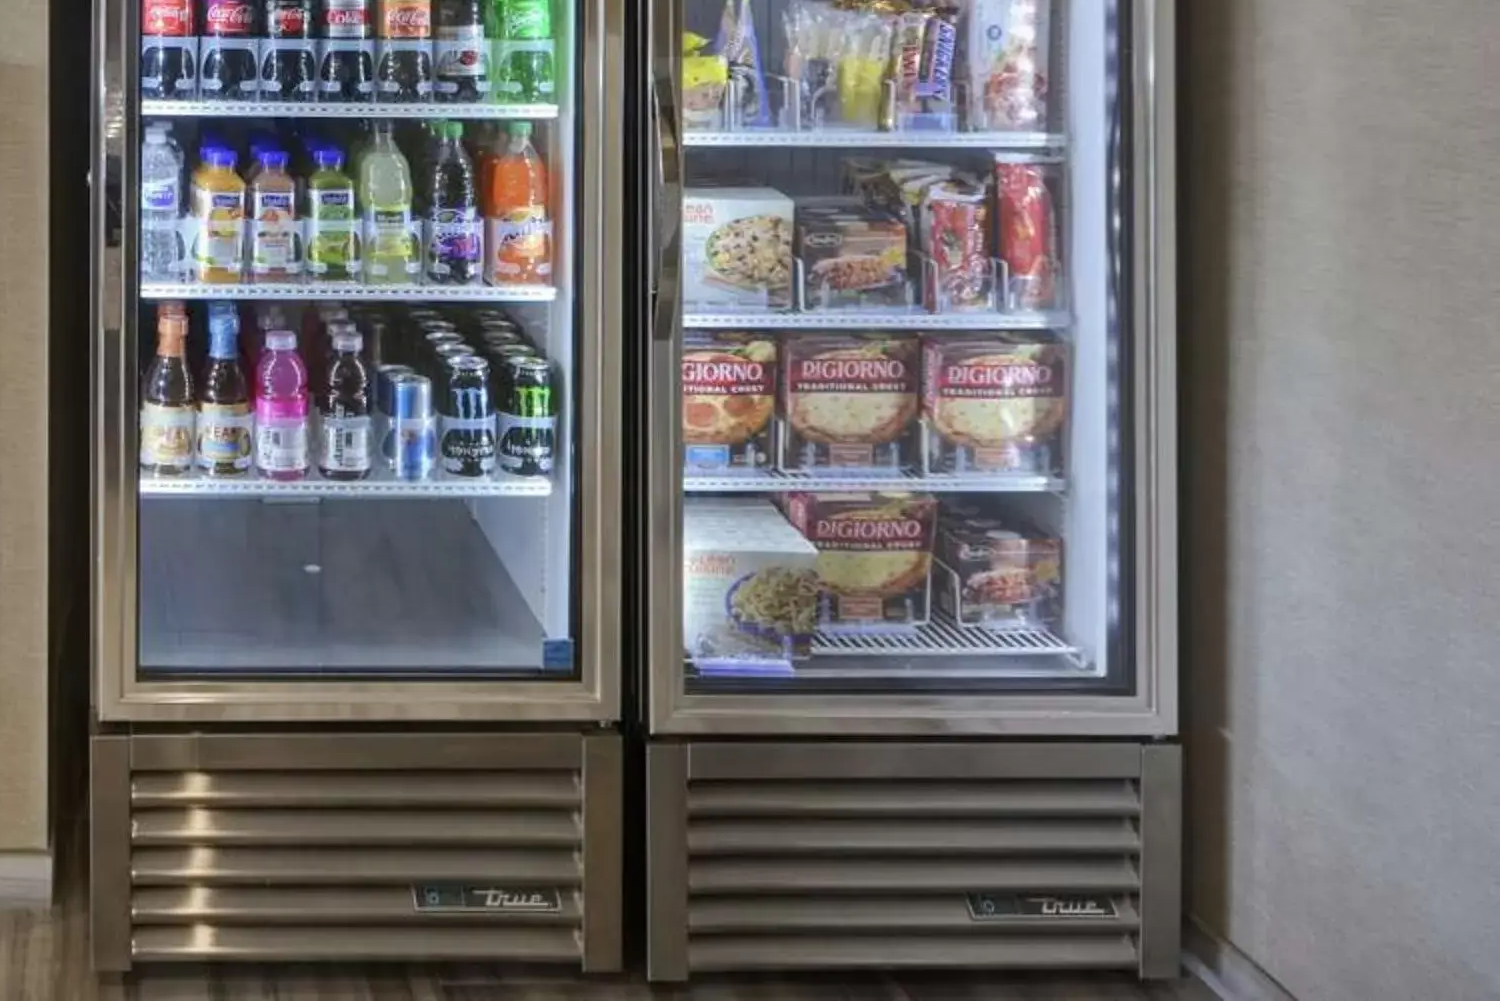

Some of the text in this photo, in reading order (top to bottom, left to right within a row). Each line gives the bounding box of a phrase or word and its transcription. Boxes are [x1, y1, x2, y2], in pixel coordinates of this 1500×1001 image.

[682, 362, 763, 381] GIORNO
[802, 360, 904, 380] DIGIORNO
[948, 366, 1053, 385] DIGIORNO
[817, 520, 922, 538] DIGIORNO
[472, 889, 549, 907] True
[1026, 897, 1105, 914] True
